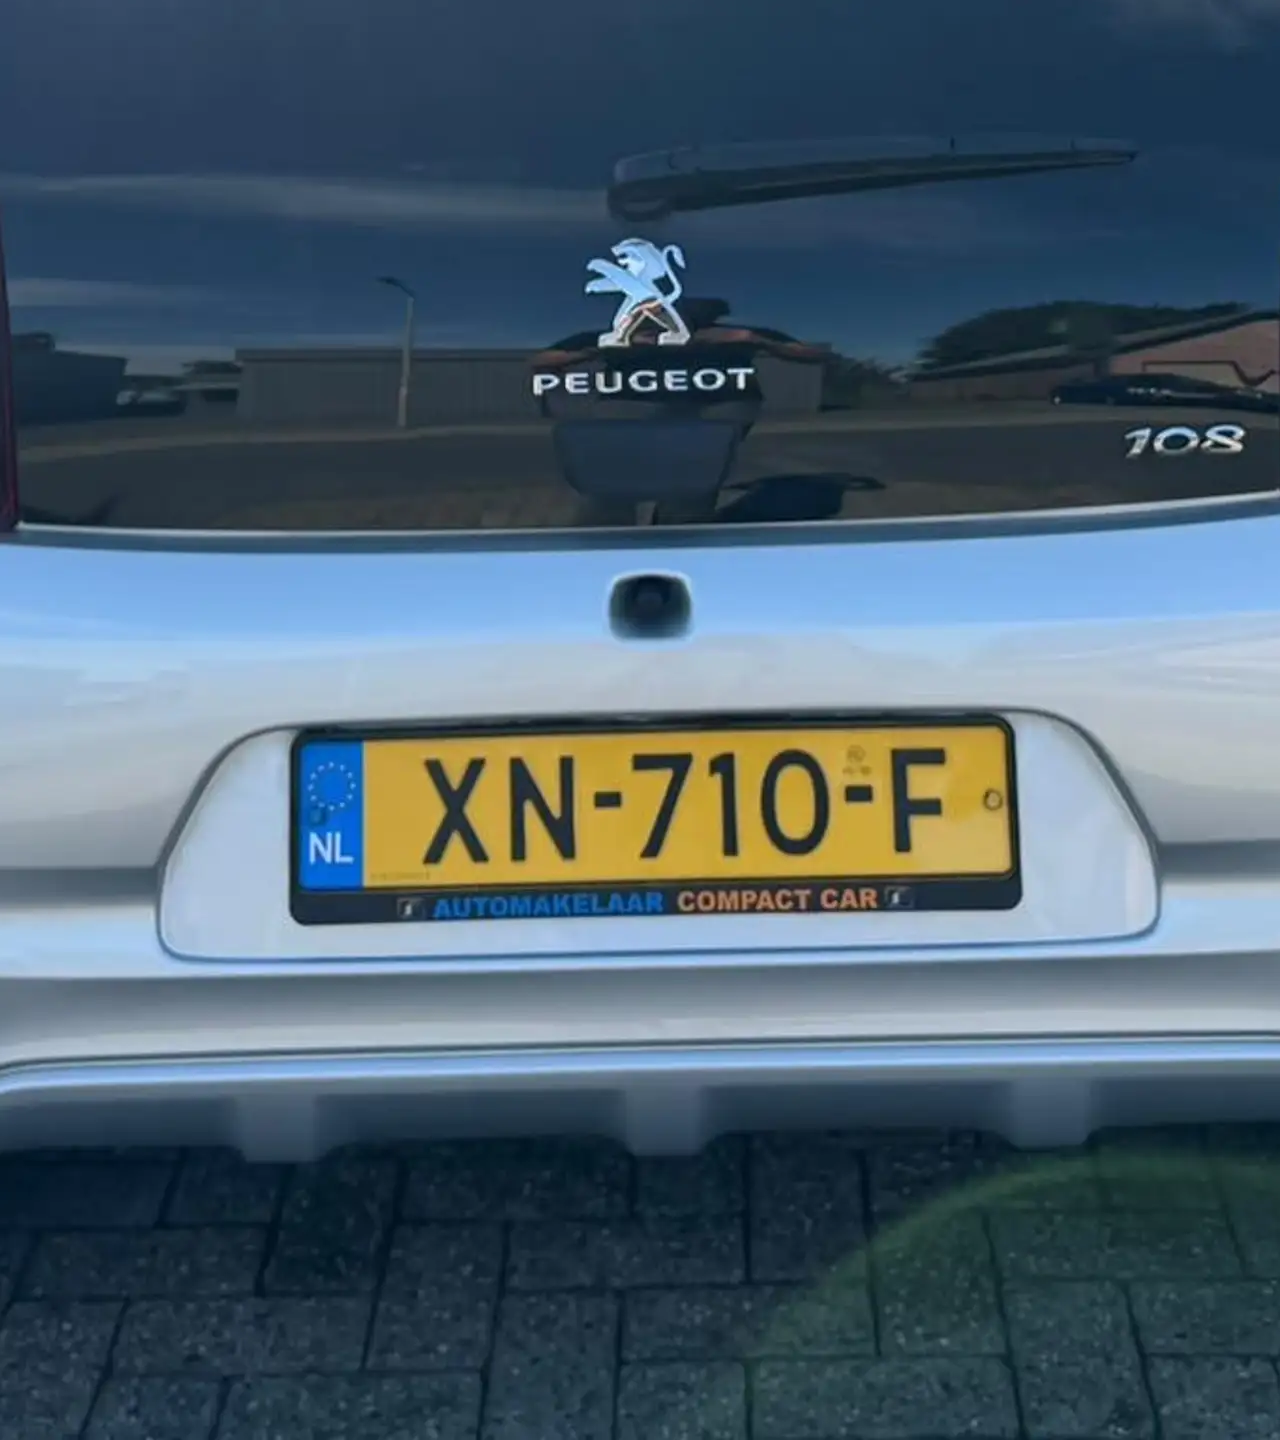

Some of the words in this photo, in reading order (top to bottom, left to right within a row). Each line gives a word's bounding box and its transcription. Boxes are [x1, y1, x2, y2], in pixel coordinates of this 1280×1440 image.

[532, 367, 754, 397] PEUGEOT
[1124, 424, 1246, 459] 108
[422, 748, 947, 865] XN-710-F
[309, 831, 354, 865] NL
[433, 889, 663, 918] AUTOMAKELAAR
[678, 887, 814, 914] COMPACT
[821, 887, 878, 910] CAR
